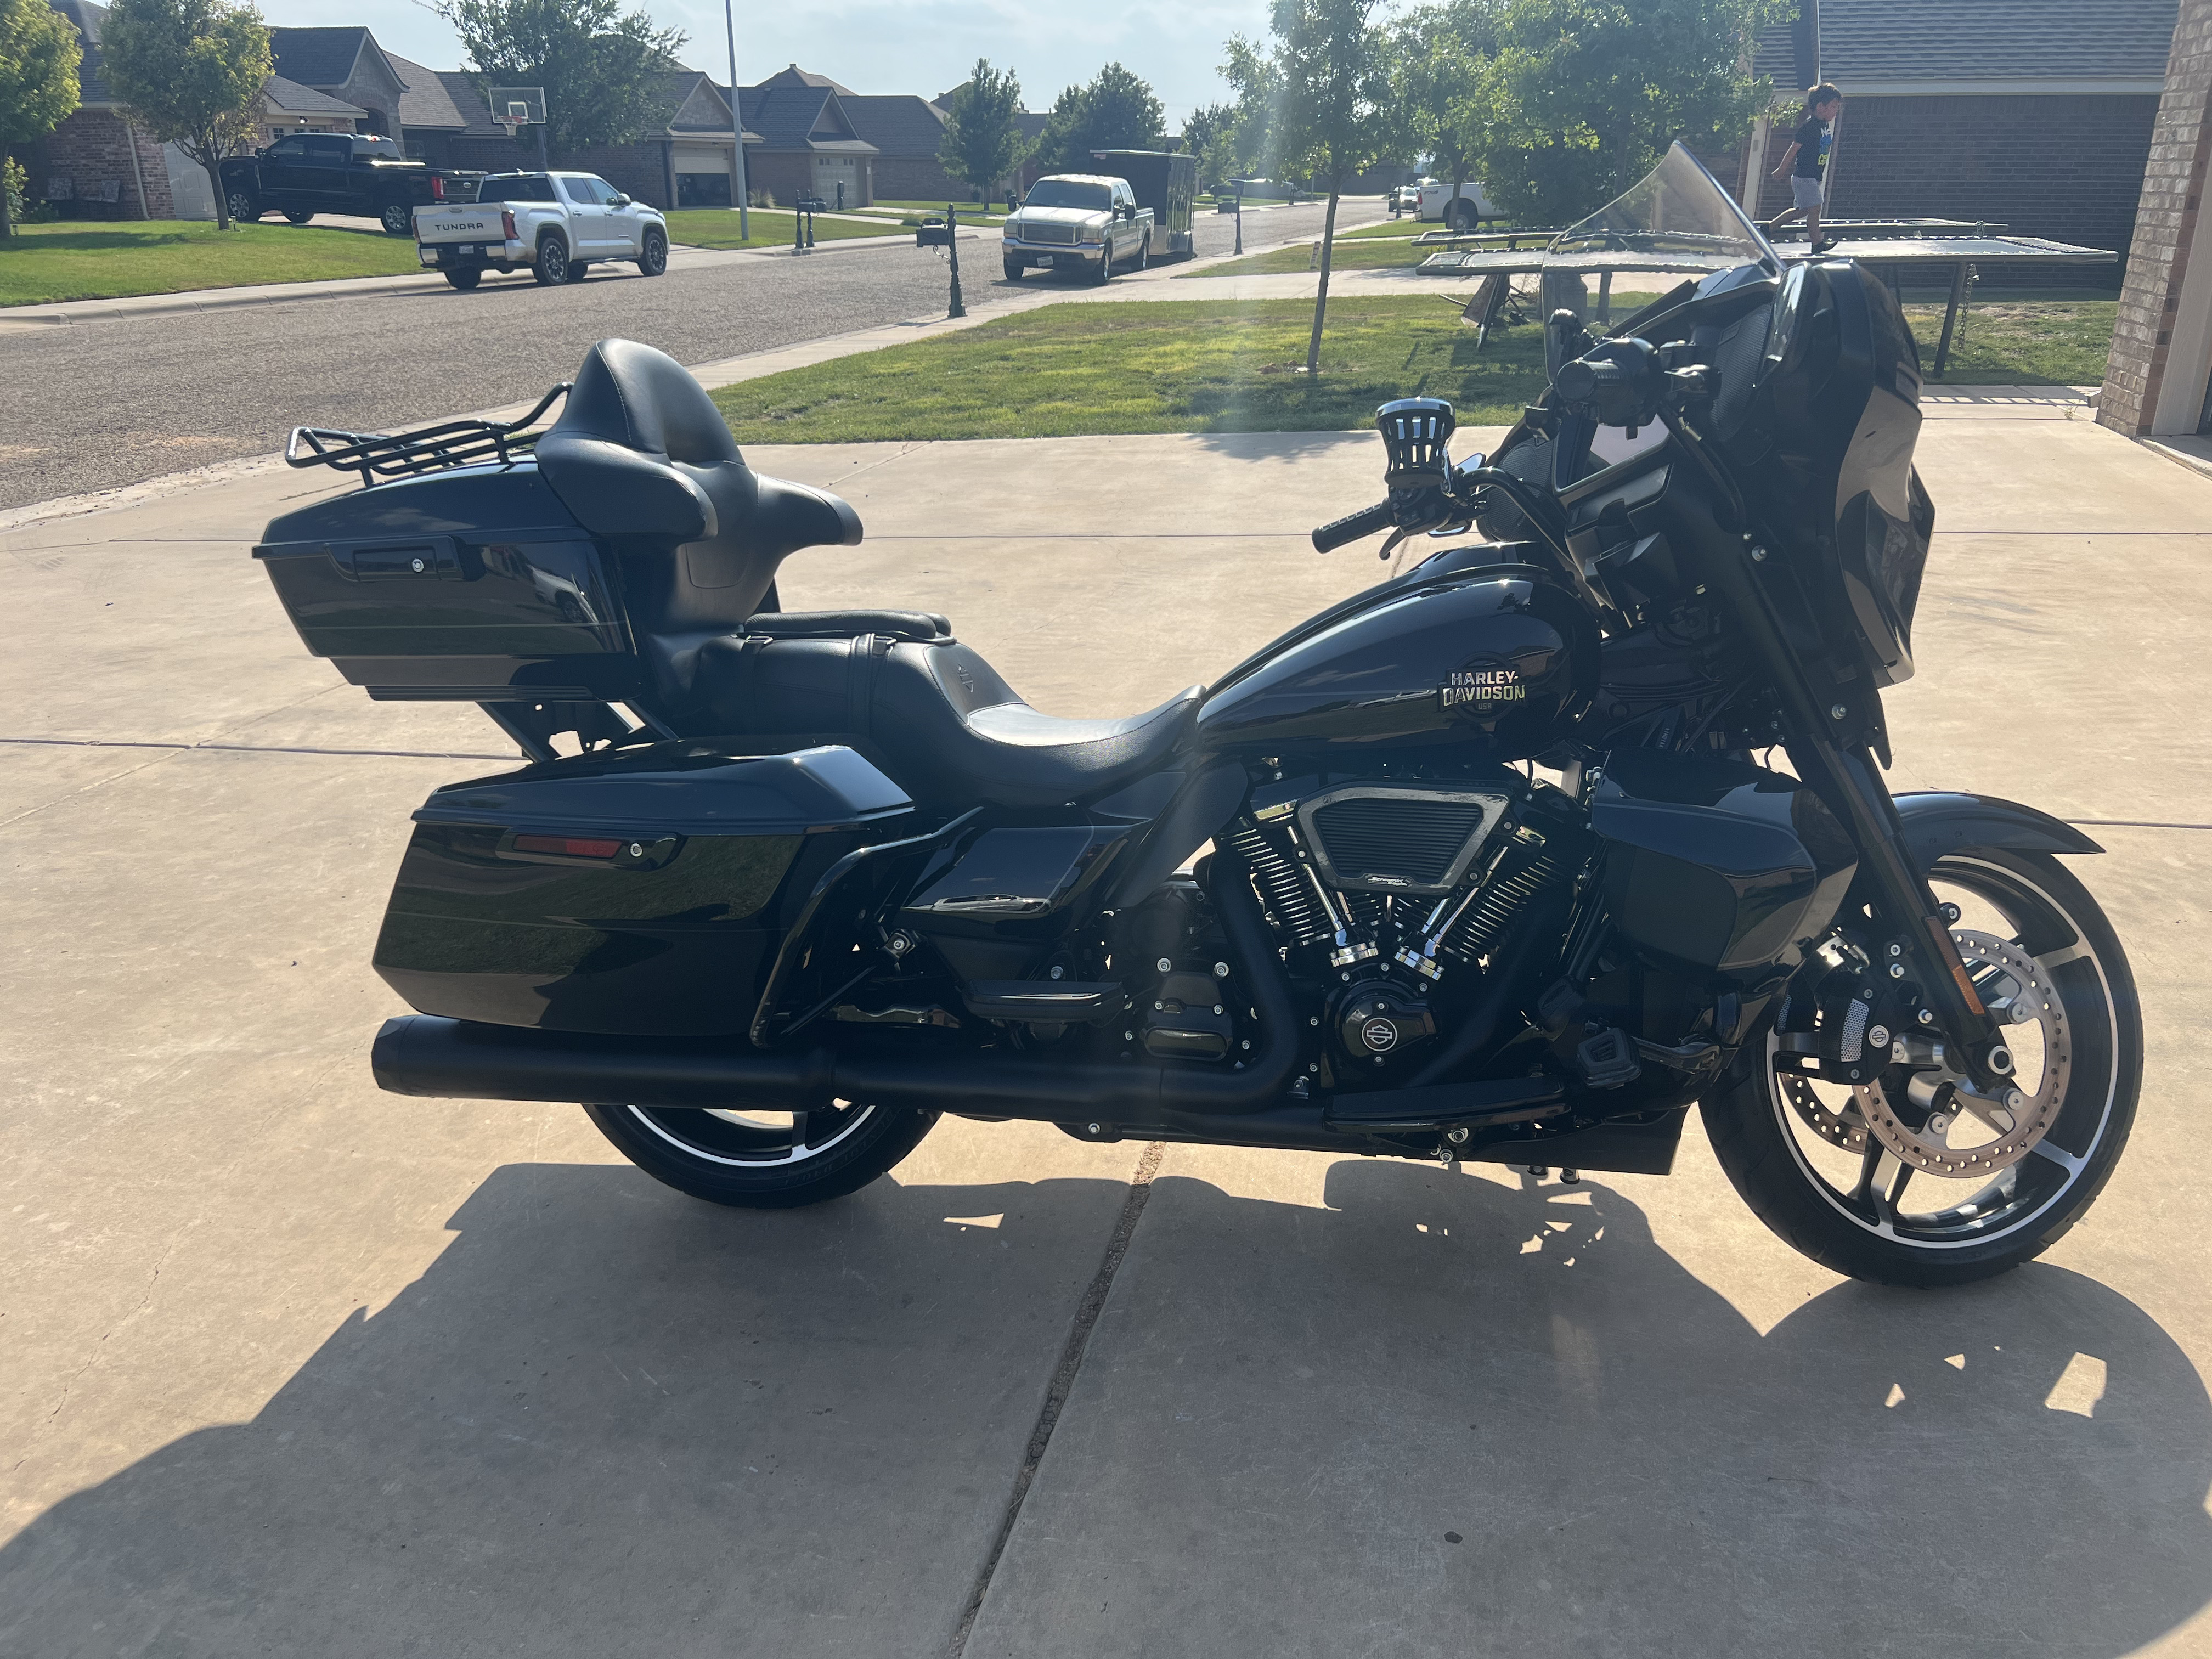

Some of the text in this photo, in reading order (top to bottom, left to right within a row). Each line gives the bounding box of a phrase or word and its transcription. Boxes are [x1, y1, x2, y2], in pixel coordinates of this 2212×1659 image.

[435, 223, 484, 231] TUNDRA
[1451, 670, 1519, 686] HARLEY-
[1443, 685, 1525, 707] DAVIDSON
